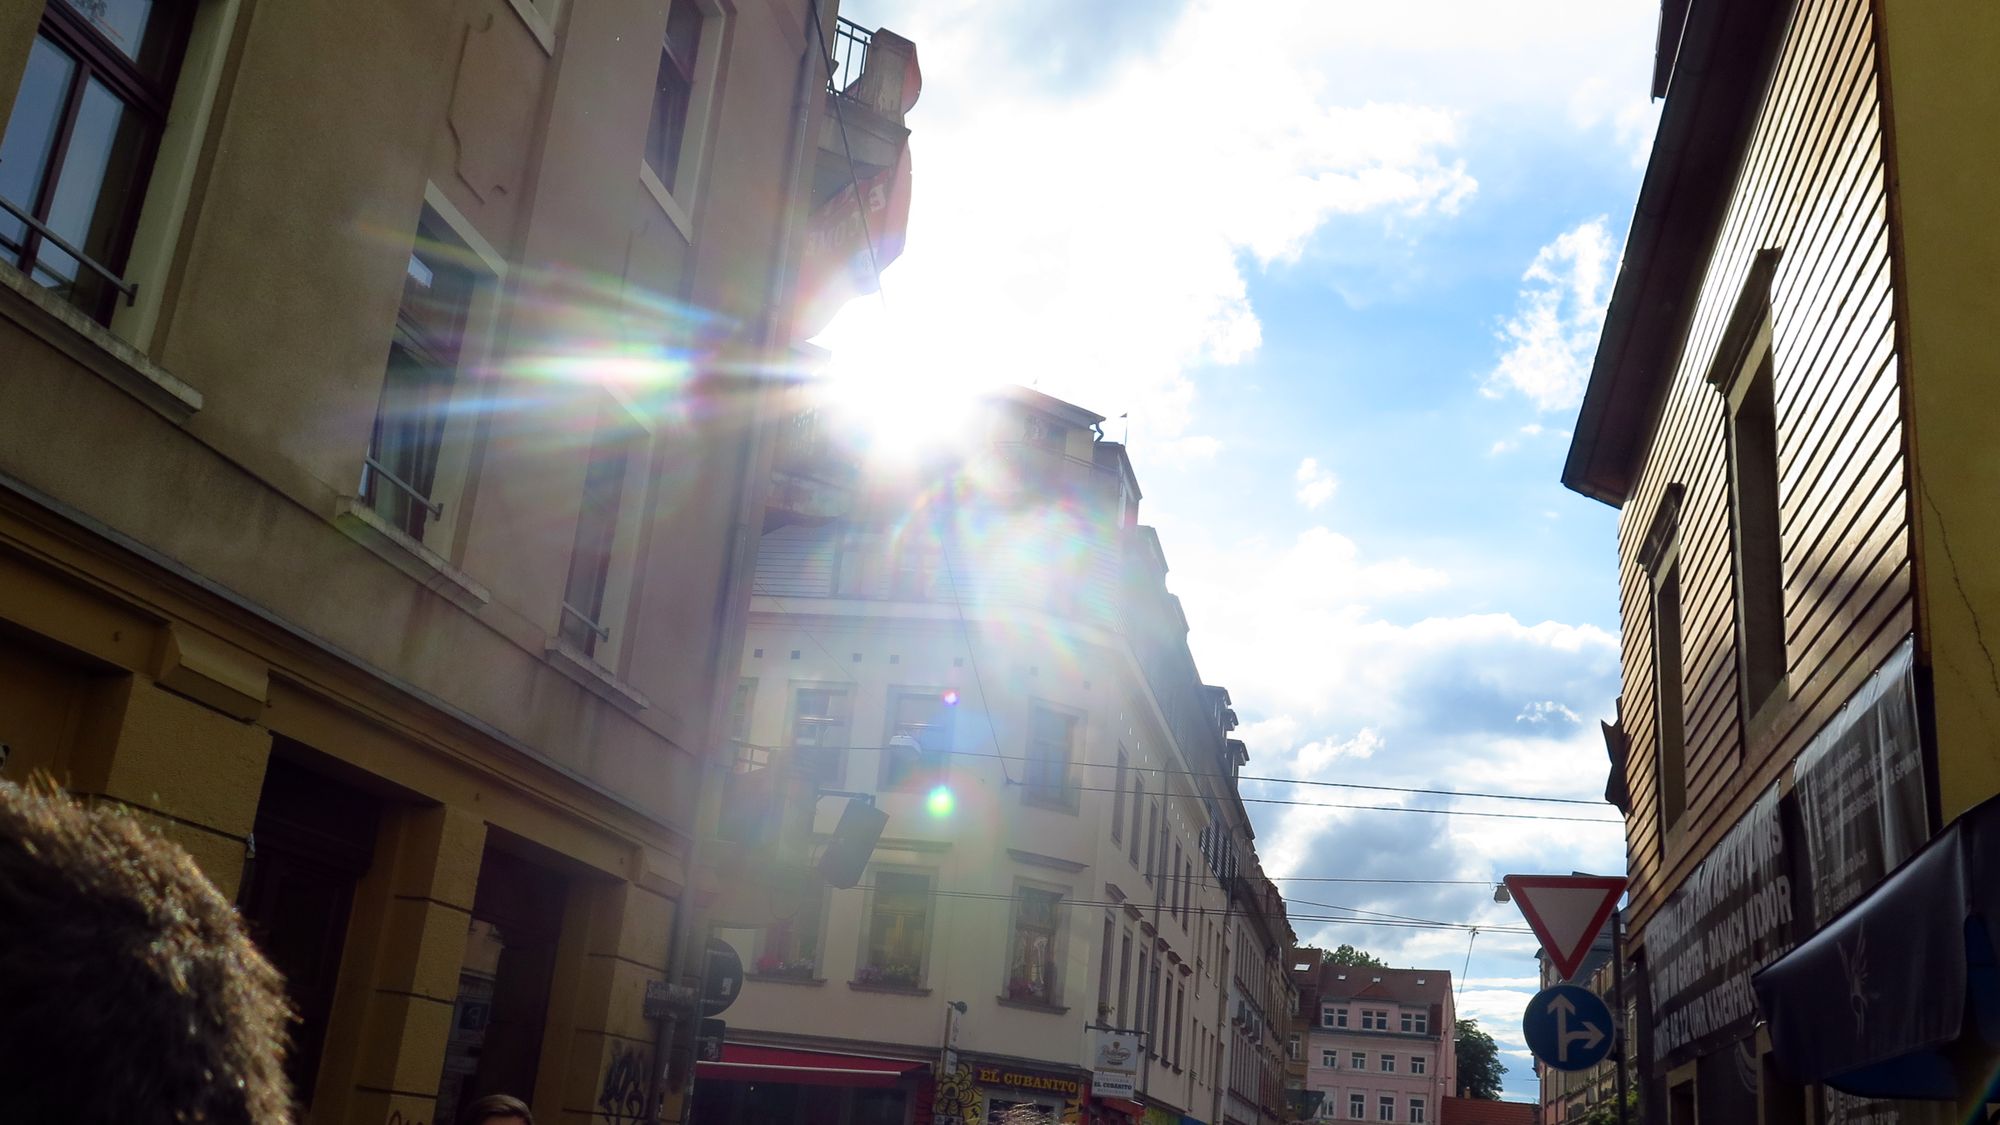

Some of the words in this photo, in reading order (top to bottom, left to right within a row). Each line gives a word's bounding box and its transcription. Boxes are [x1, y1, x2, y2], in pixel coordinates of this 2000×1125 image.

[1677, 936, 1705, 992] GARTEN
[1707, 905, 1746, 970] DANACH
[1745, 873, 1794, 945] INDOOR
[979, 1068, 1000, 1083] EL
[1003, 1073, 1077, 1092] CUBANITO
